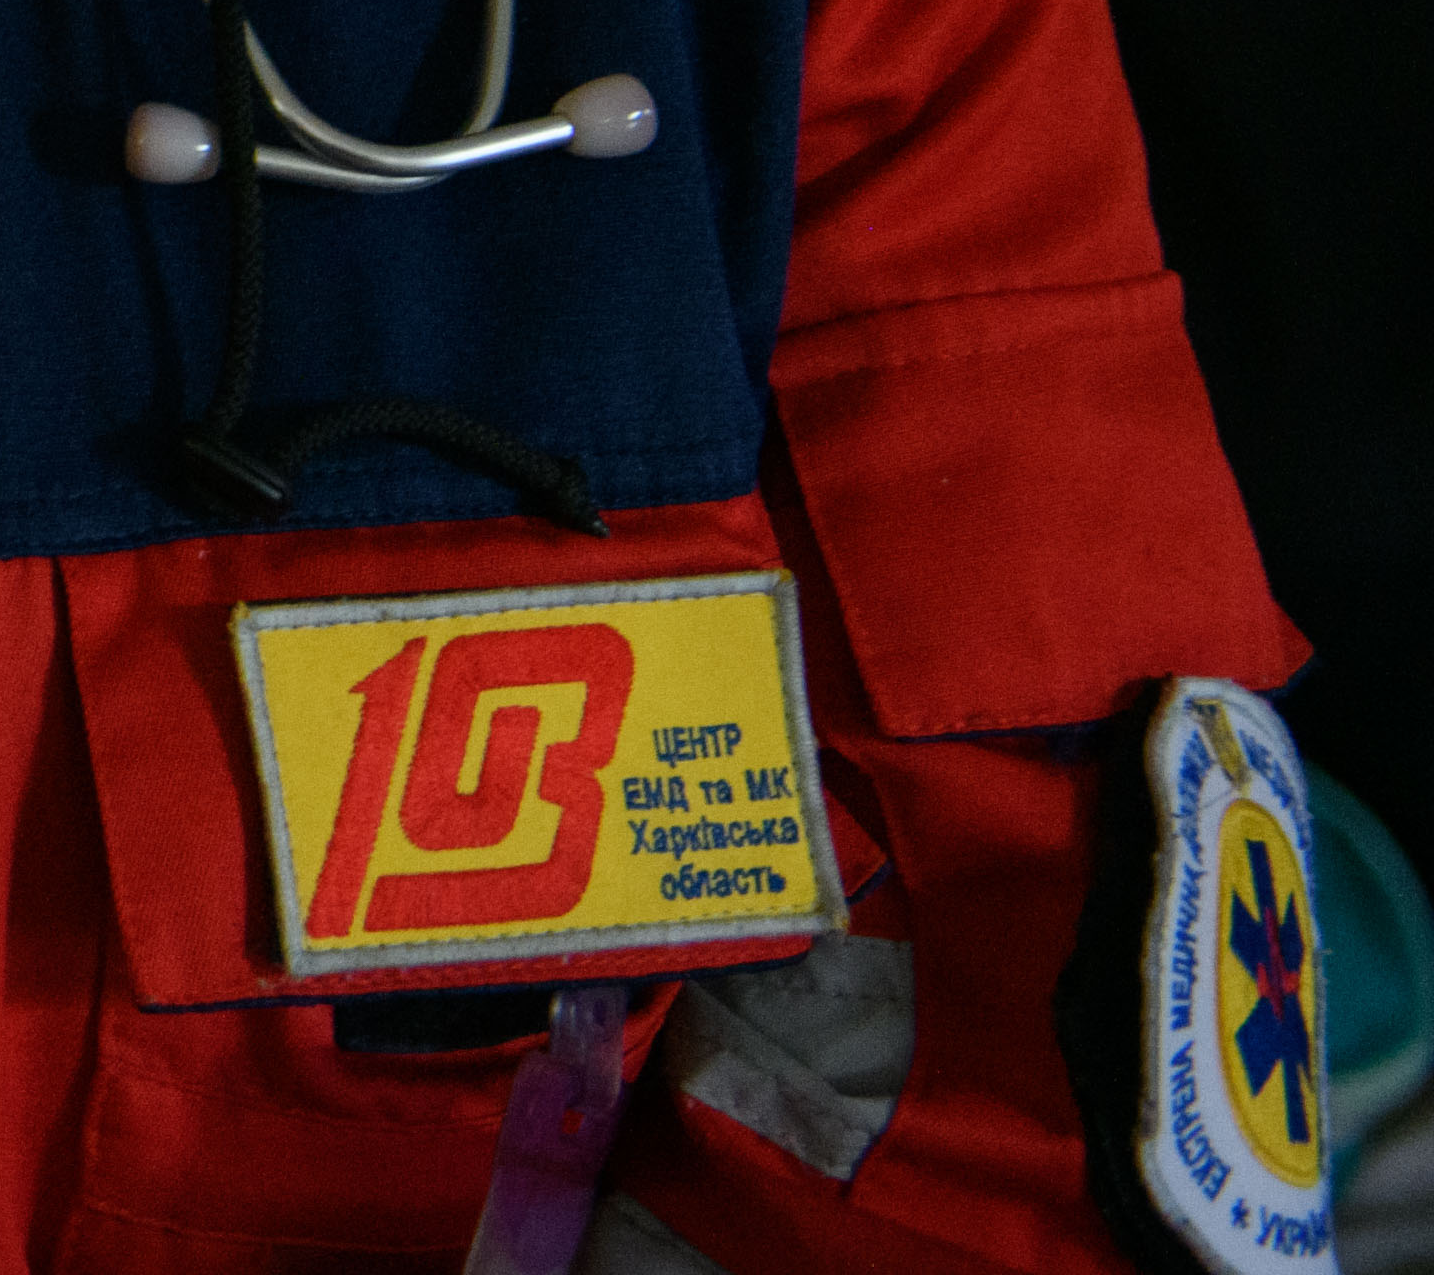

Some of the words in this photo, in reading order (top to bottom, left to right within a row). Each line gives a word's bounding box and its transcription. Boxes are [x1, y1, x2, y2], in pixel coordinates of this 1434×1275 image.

[653, 723, 741, 768] ЦЕНТР
[305, 623, 635, 939] 103
[623, 776, 689, 813] ЕМД
[699, 778, 733, 805] та
[745, 767, 793, 801] МК
[628, 816, 799, 861] Харківська
[660, 863, 787, 901] область
[1169, 1039, 1231, 1201] ЕКСТРЕНА
